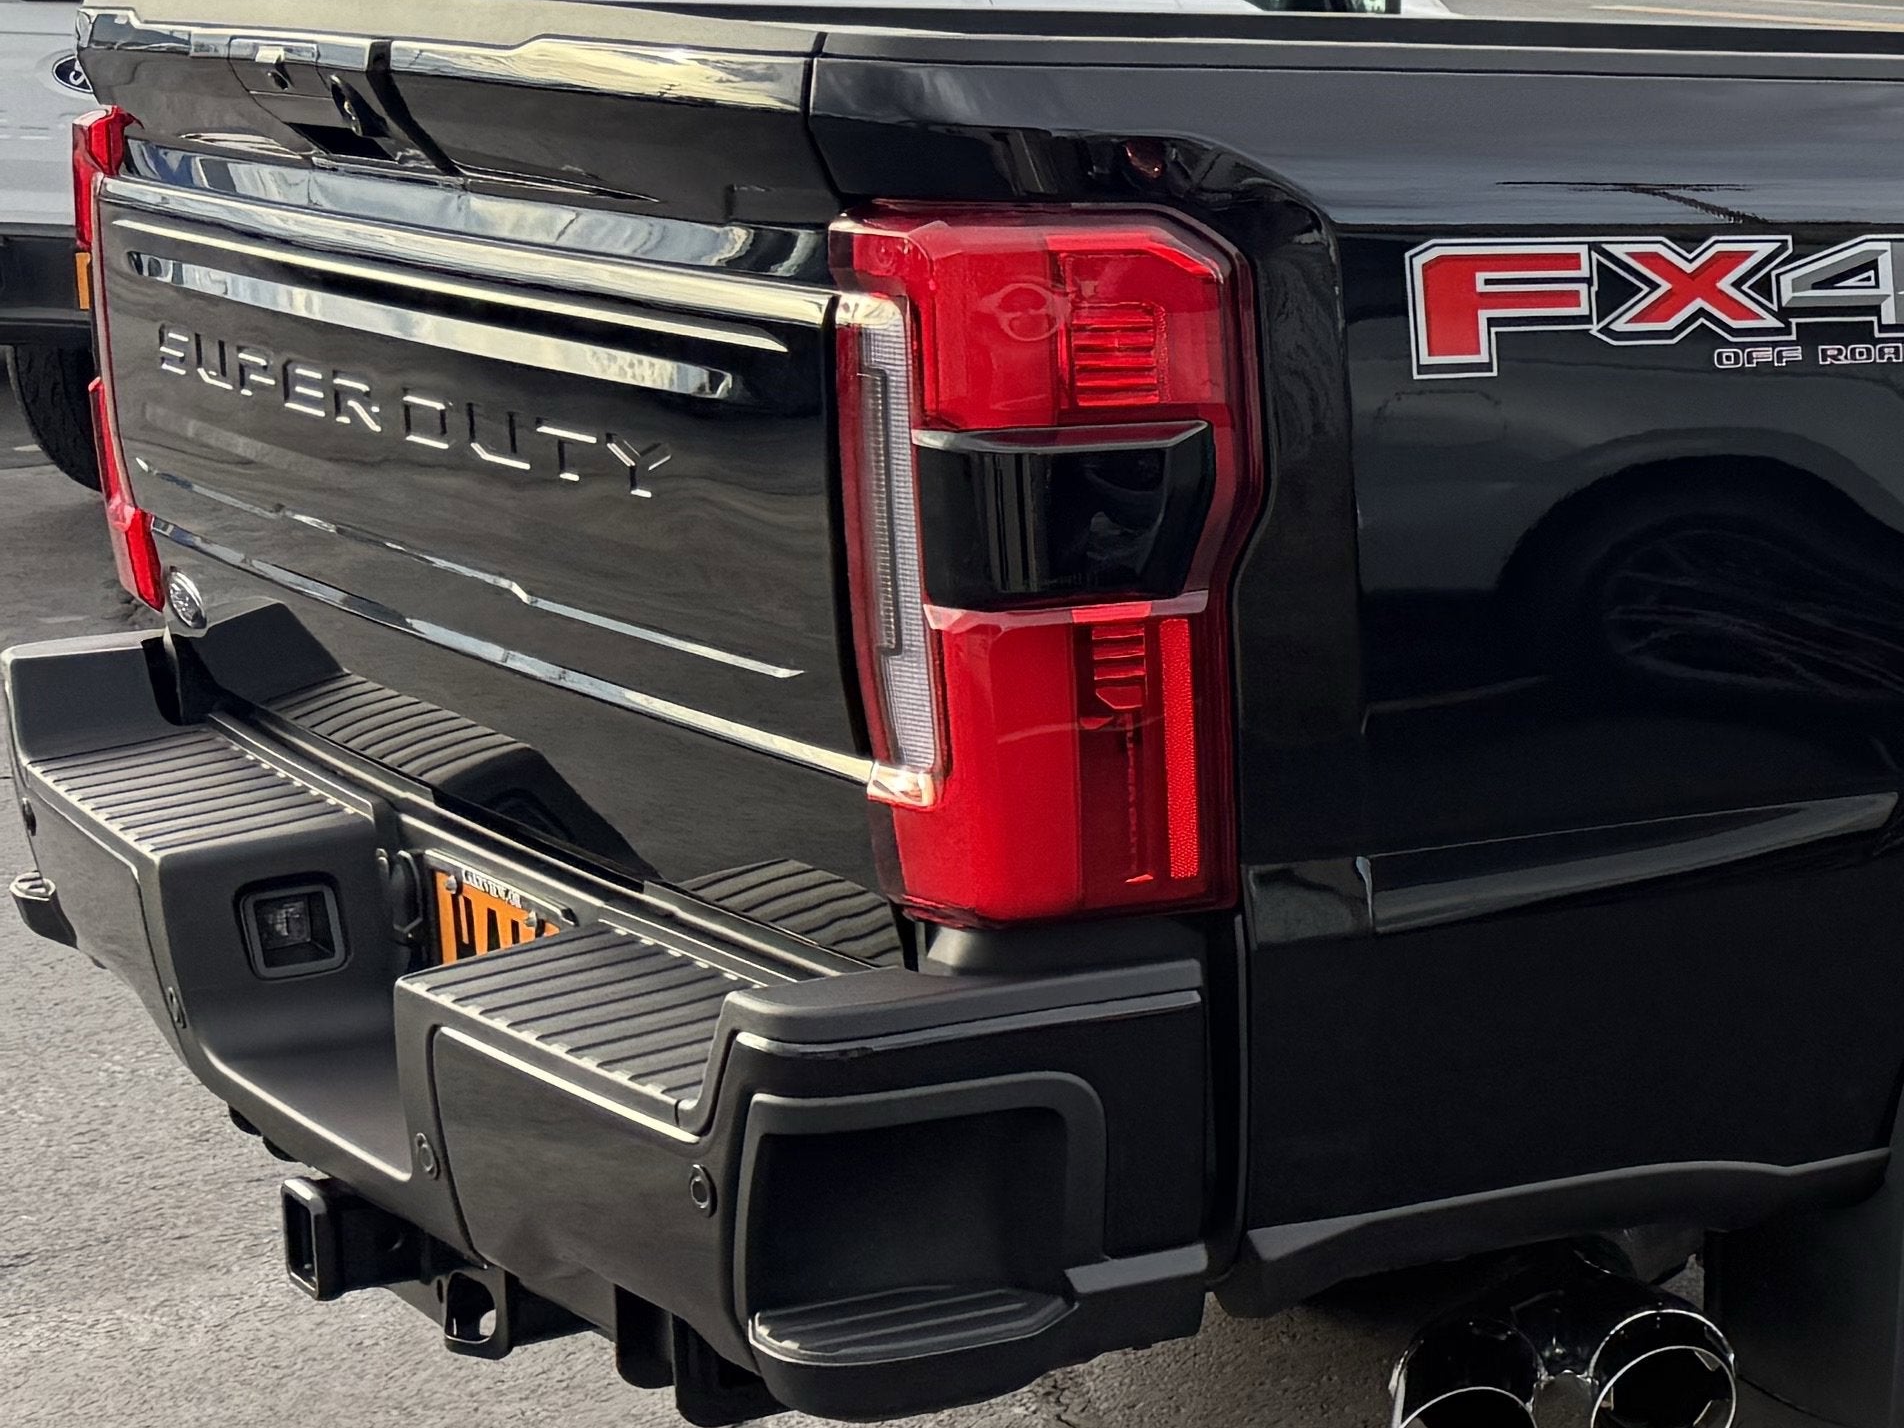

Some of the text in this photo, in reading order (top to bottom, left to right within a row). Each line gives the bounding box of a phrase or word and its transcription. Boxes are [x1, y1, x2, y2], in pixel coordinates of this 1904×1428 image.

[1714, 345, 1802, 369] OFF
[158, 322, 672, 499] SUPER DUTY
